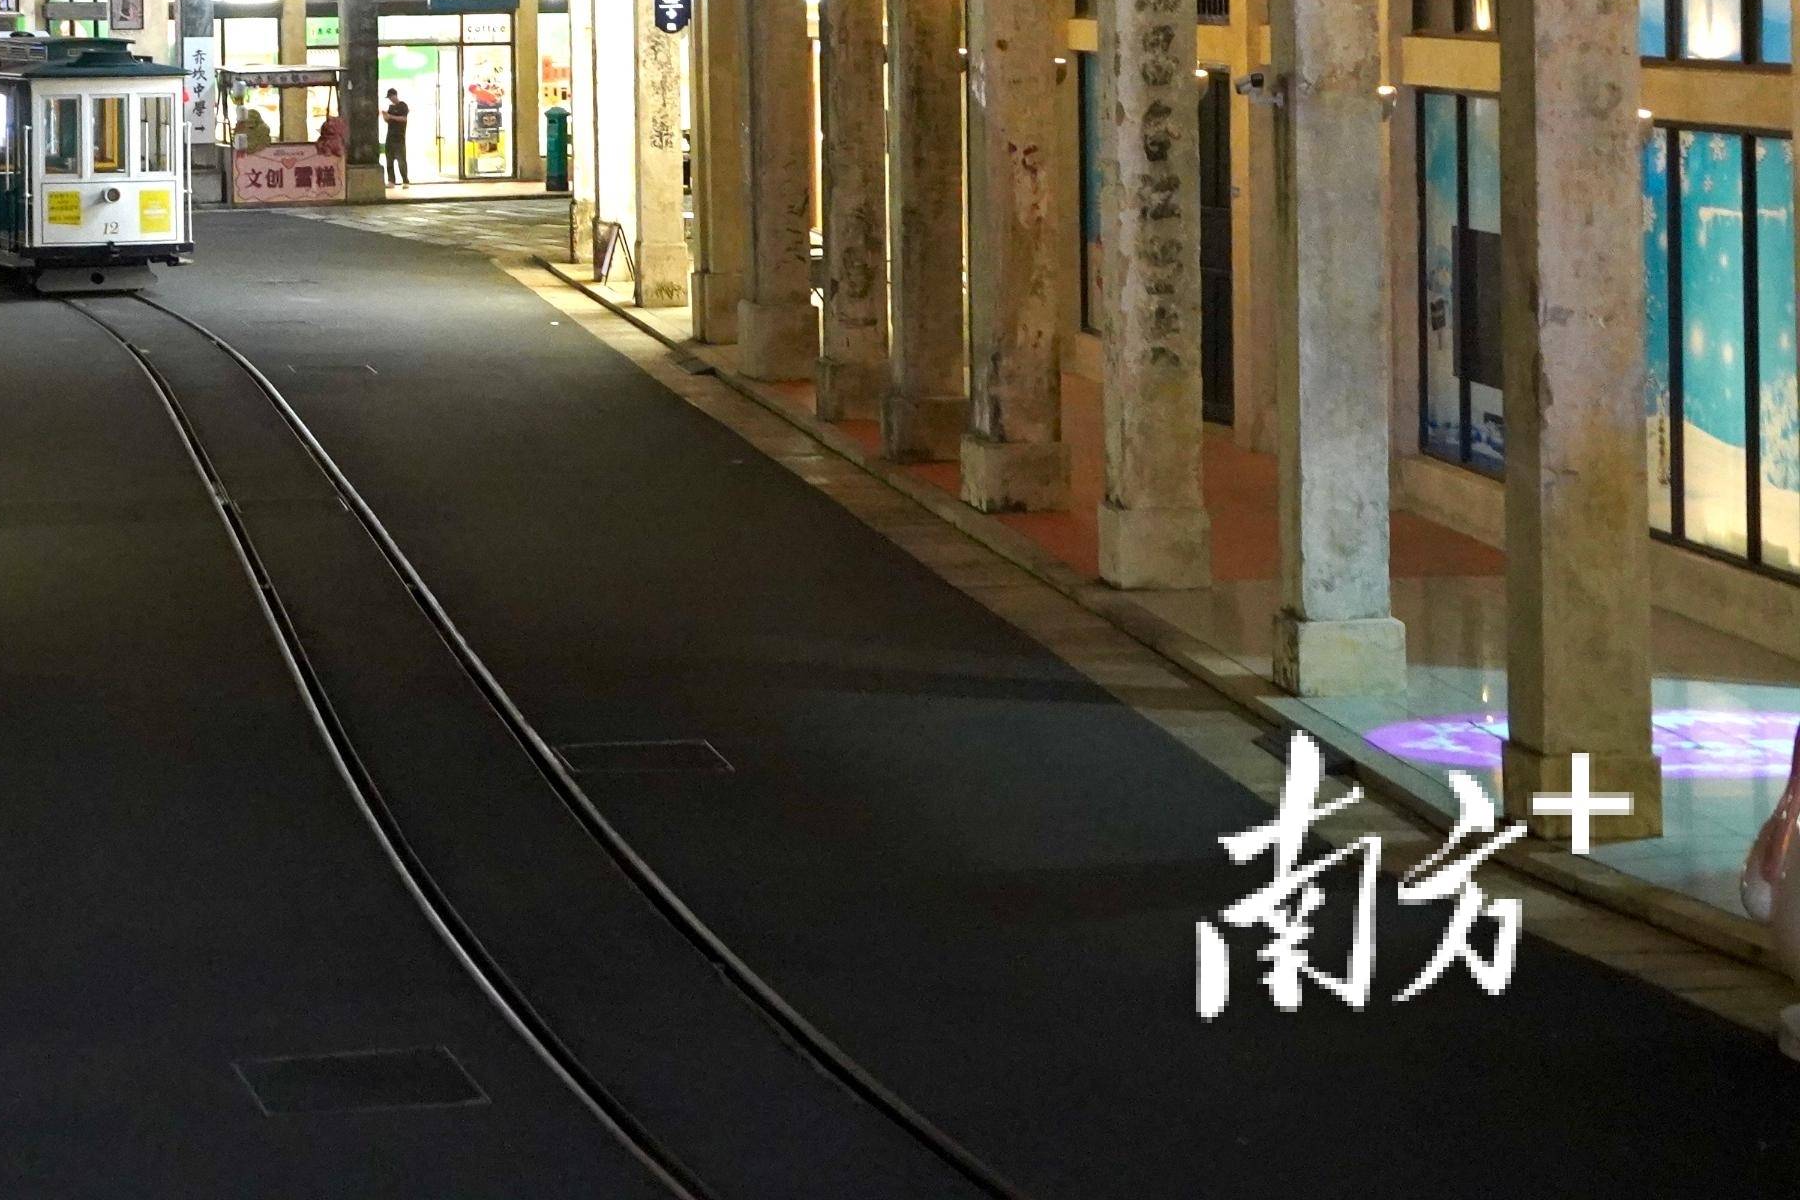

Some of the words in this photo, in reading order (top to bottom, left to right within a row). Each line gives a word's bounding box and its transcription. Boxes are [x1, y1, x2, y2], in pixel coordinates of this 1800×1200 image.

[244, 168, 284, 189] 文创
[294, 166, 336, 188] 雪糕
[102, 221, 120, 235] 12
